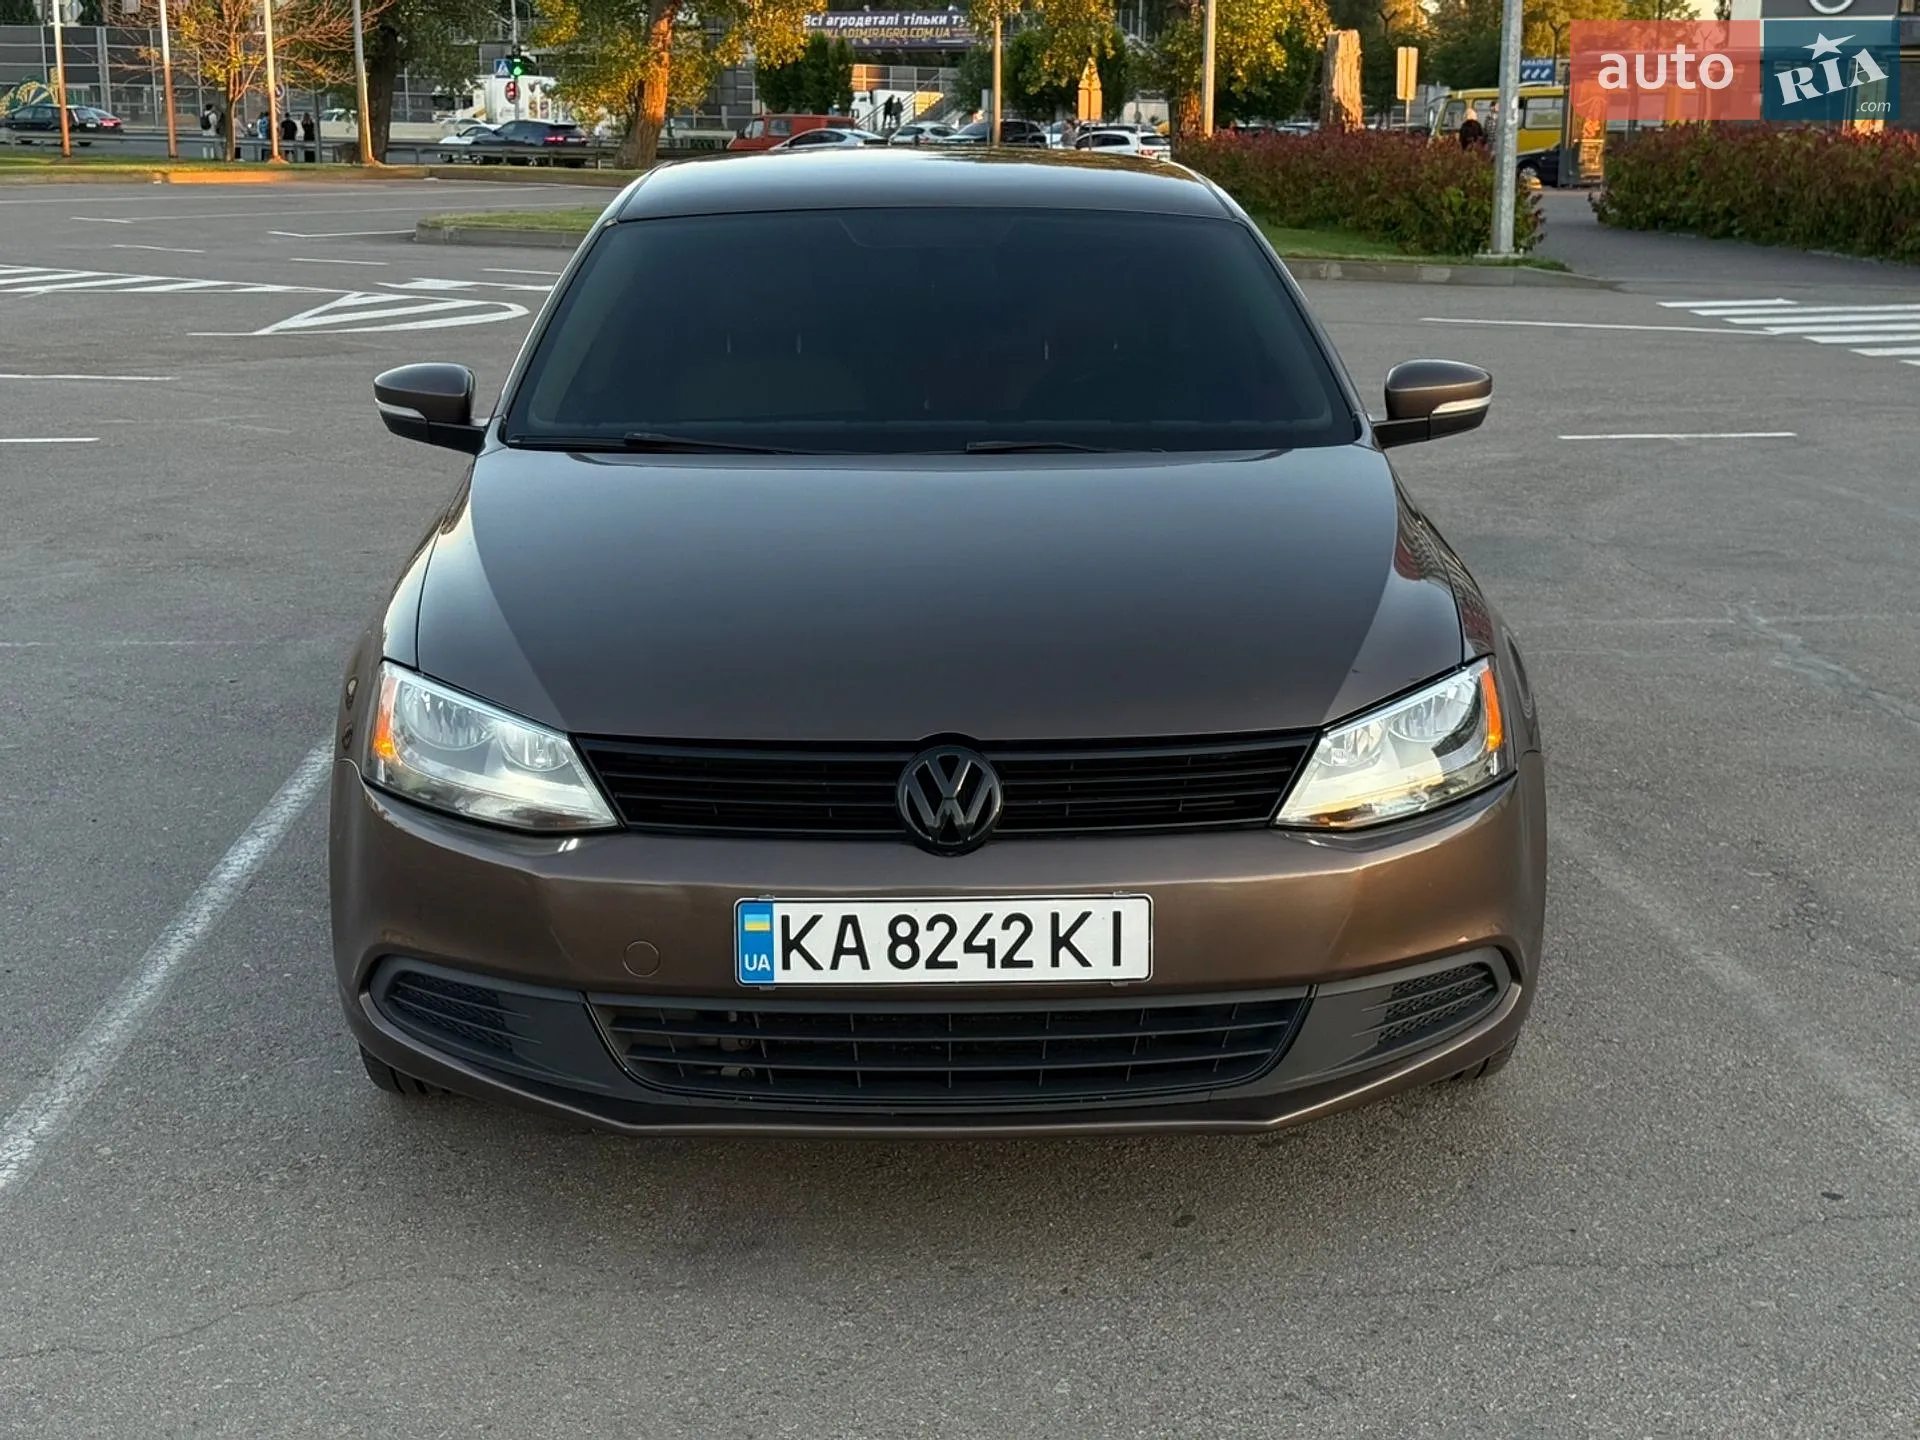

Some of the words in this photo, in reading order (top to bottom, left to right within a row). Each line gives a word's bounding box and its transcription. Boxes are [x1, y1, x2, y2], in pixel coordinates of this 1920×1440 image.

[825, 13, 899, 28] агродеталі
[903, 13, 947, 26] тільки
[781, 914, 872, 972] KA
[887, 911, 1034, 971] 8242
[1050, 910, 1123, 968] KI
[744, 953, 771, 972] UA
